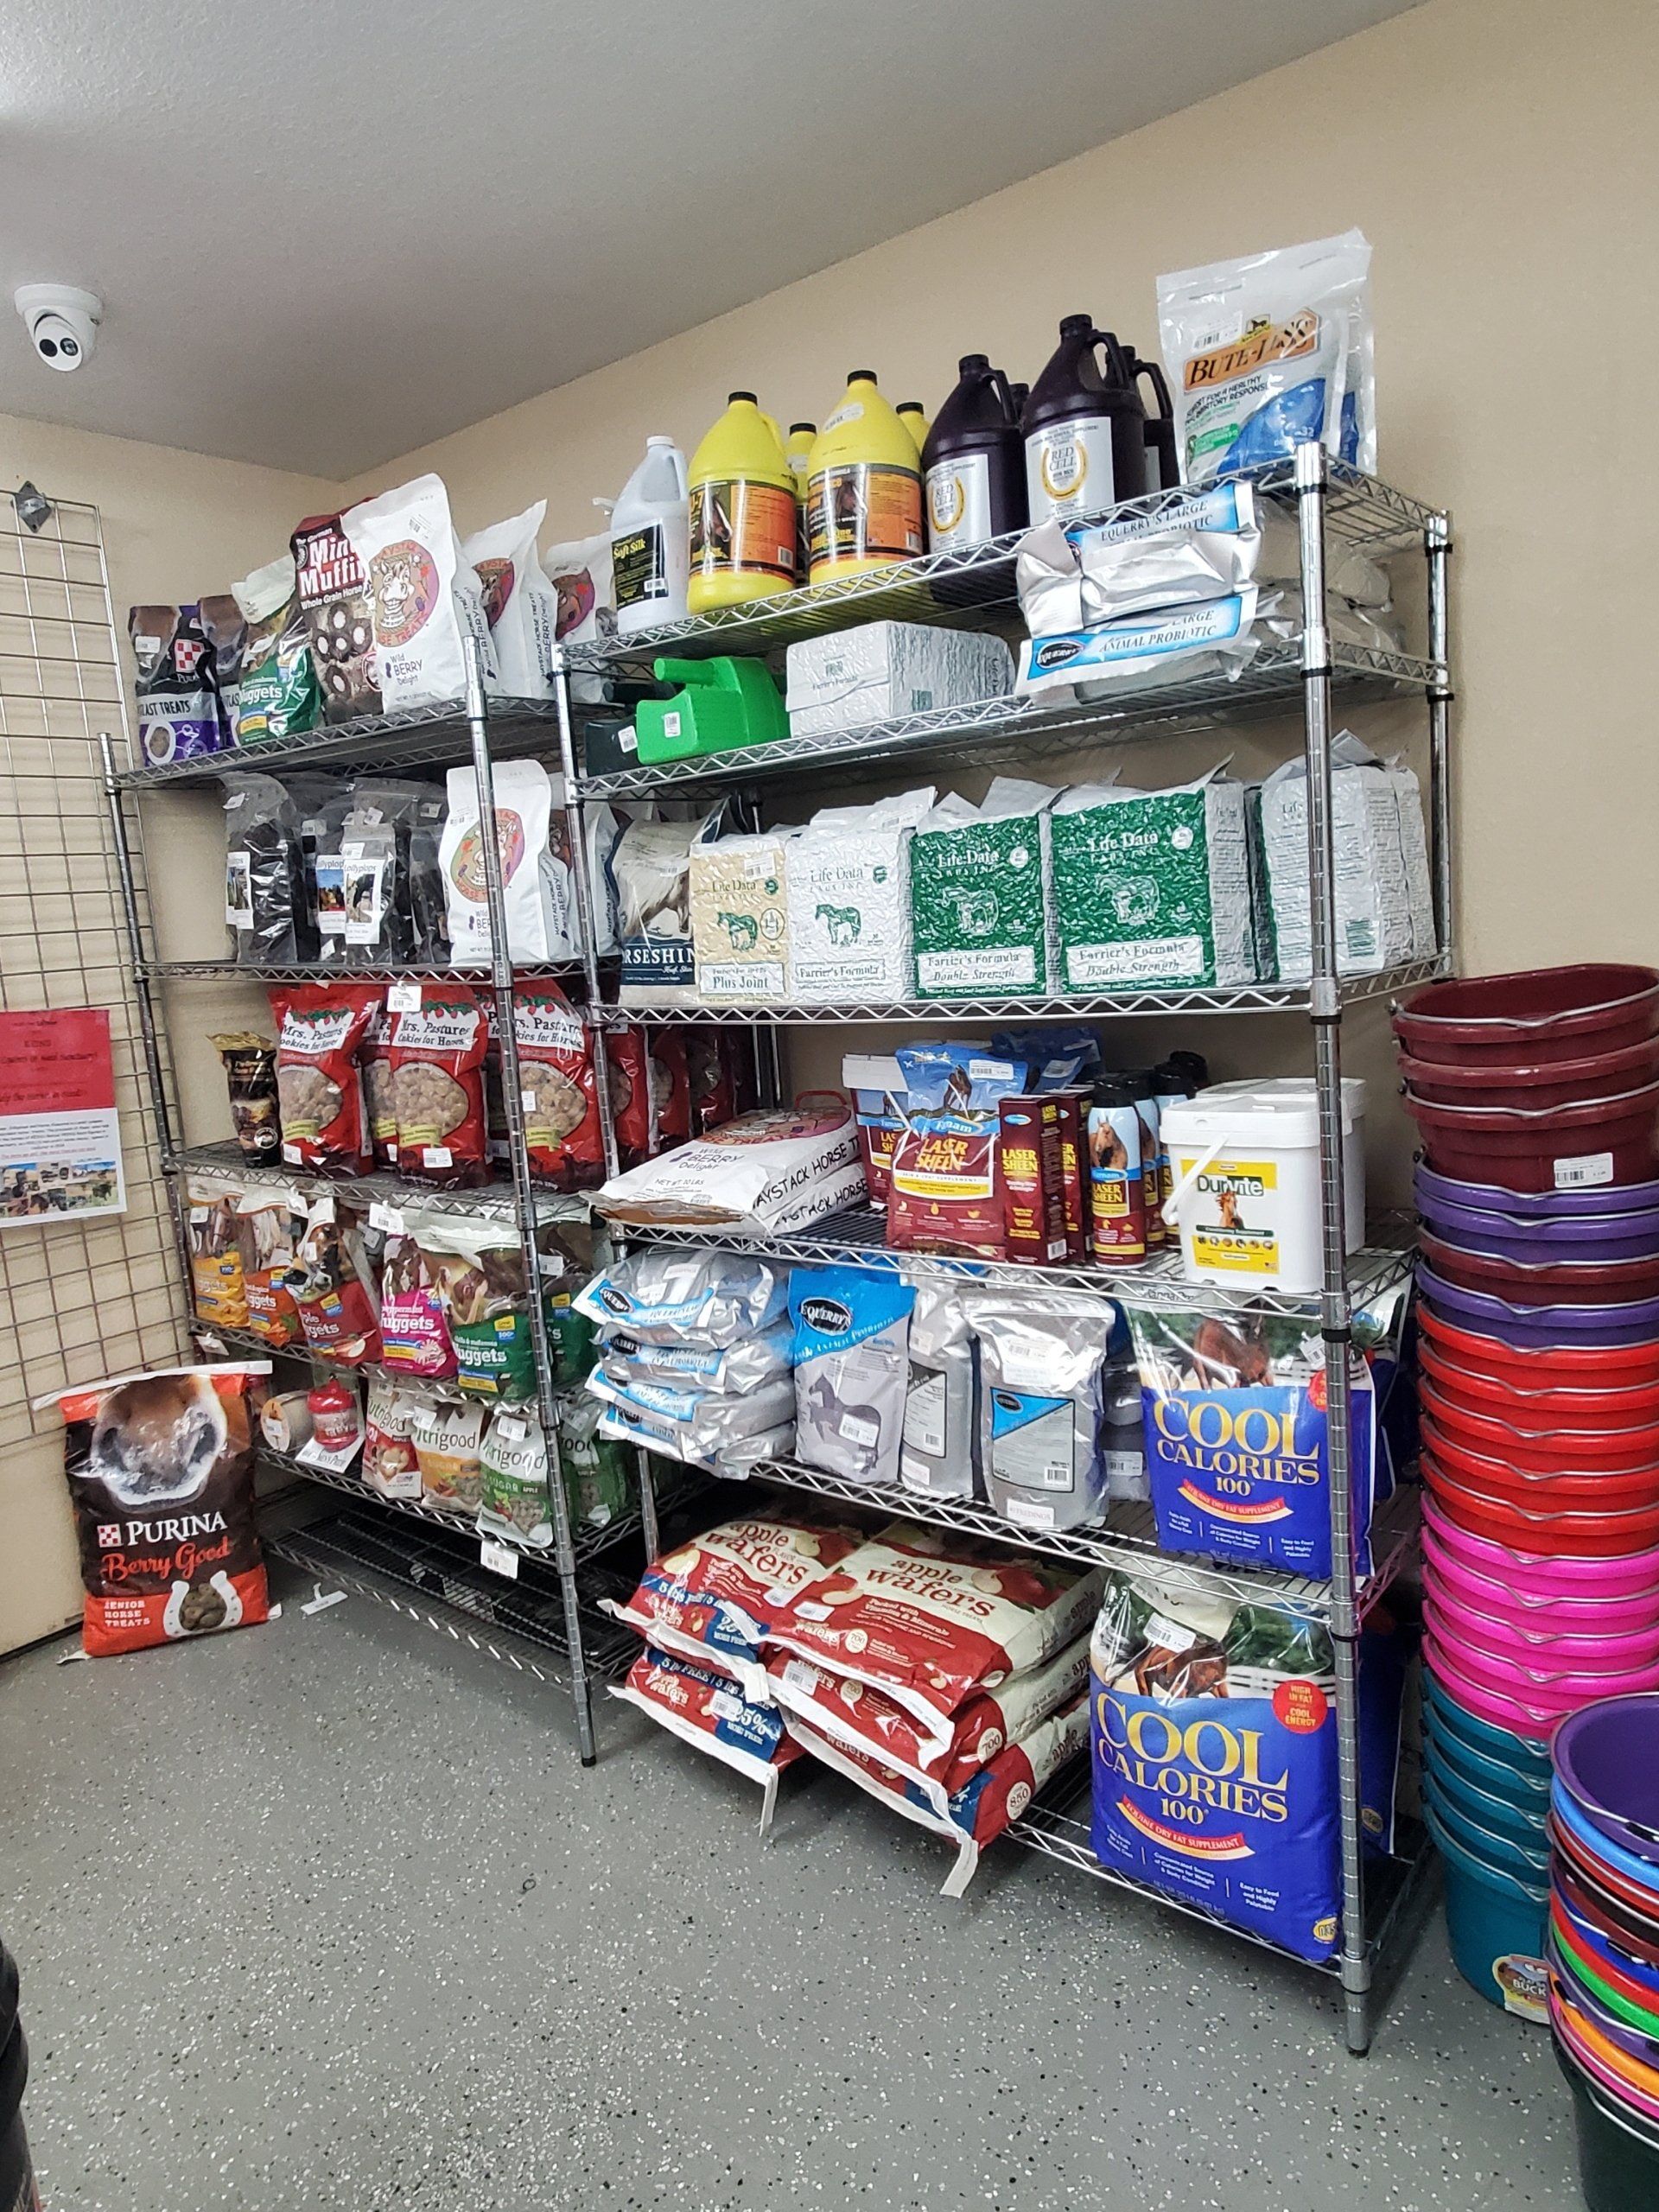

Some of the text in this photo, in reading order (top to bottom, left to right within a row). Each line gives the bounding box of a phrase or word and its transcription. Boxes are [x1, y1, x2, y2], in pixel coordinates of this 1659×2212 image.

[1052, 446, 1074, 461] RED
[1049, 456, 1076, 472] CELL
[936, 484, 954, 496] RED
[935, 493, 954, 506] CELL
[301, 596, 322, 610] Whole
[323, 590, 342, 603] Grain
[1098, 625, 1217, 654] ANIMAL PROBIOTIC
[393, 658, 423, 676] BERRY
[397, 674, 419, 685] Delight
[160, 700, 191, 715] TREATS
[1090, 830, 1159, 853] Life Data
[938, 848, 1000, 868] Life Data
[810, 867, 864, 882] Life Data
[734, 879, 757, 891] Data
[976, 951, 1020, 964] Formula
[934, 967, 1015, 982] Double Strength
[1086, 959, 1179, 976] Double Strength
[713, 976, 768, 989] Plus Joint
[283, 1025, 307, 1039] Mrs.
[537, 1033, 550, 1043] for
[921, 1138, 969, 1155] LASER
[1002, 1148, 1037, 1161] LASER
[677, 1161, 719, 1171] Delight
[688, 1154, 745, 1164] BERRY
[811, 1142, 847, 1174] HORSE
[914, 1153, 965, 1173] SHEEN
[1002, 1160, 1039, 1172] SHEEN
[1154, 1396, 1319, 1460] COOL
[1157, 1439, 1320, 1485] CALORIES
[1215, 1476, 1251, 1497] 100
[1238, 1502, 1281, 1515] SUPPLEMENT
[126, 1510, 228, 1547] PURINA
[729, 1522, 789, 1548] apple
[100, 1535, 232, 1581] Berry Good
[705, 1533, 810, 1585] wafers
[891, 1560, 963, 1584] apple
[658, 1581, 668, 1592] 5
[867, 1569, 996, 1617] wafers
[104, 1599, 145, 1610] SENIOR
[104, 1610, 142, 1618] HORSE
[104, 1617, 150, 1628] TREATS
[661, 1657, 710, 1683] 5 FREE
[1071, 1653, 1090, 1677] app
[715, 1677, 723, 1688] 5
[650, 1681, 690, 1705] wafers
[1288, 1693, 1313, 1704] IN FAT
[1285, 1715, 1316, 1727] ENERGY
[1289, 1707, 1311, 1719] COOL
[982, 1735, 1001, 1753] 700
[1096, 1692, 1289, 1790] COOL
[1098, 1738, 1288, 1823] CALORIES
[1009, 1789, 1029, 1808] 850
[1160, 1797, 1205, 1825] 100
[1126, 1802, 1240, 1850] EQUINE DRY FAT SUPPLEMENT
[1513, 1979, 1547, 1997] BUCK
